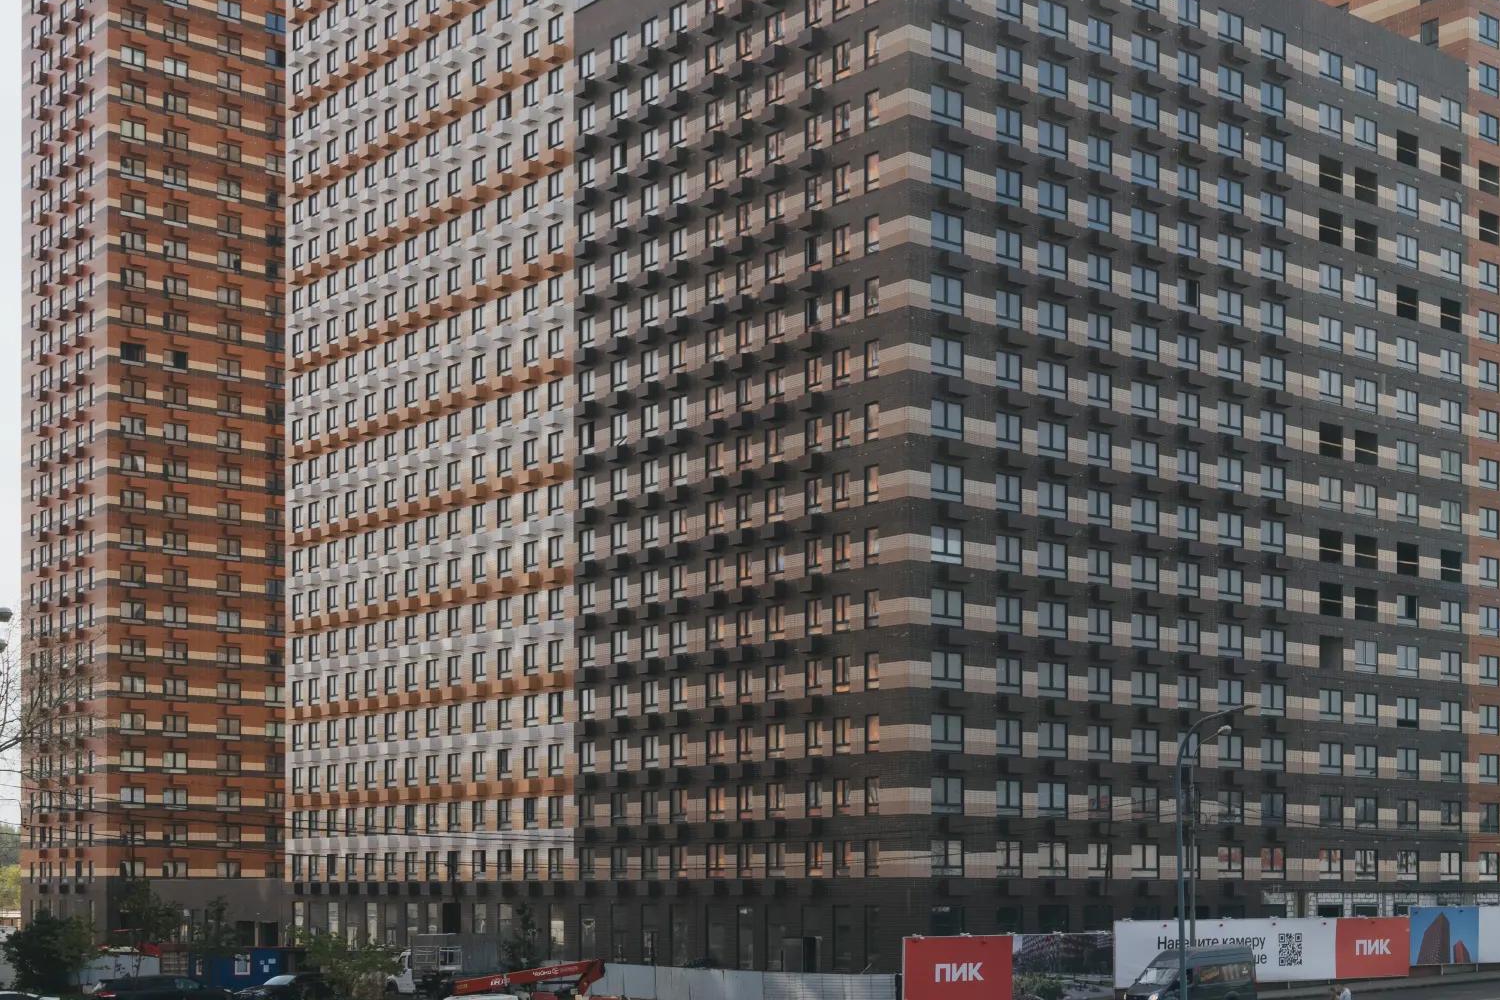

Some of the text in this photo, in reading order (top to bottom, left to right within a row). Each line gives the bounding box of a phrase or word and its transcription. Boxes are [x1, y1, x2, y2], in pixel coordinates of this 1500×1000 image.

[1157, 936, 1219, 949] Навеите
[1355, 938, 1391, 956] ПИК
[935, 962, 984, 982] ПИК
